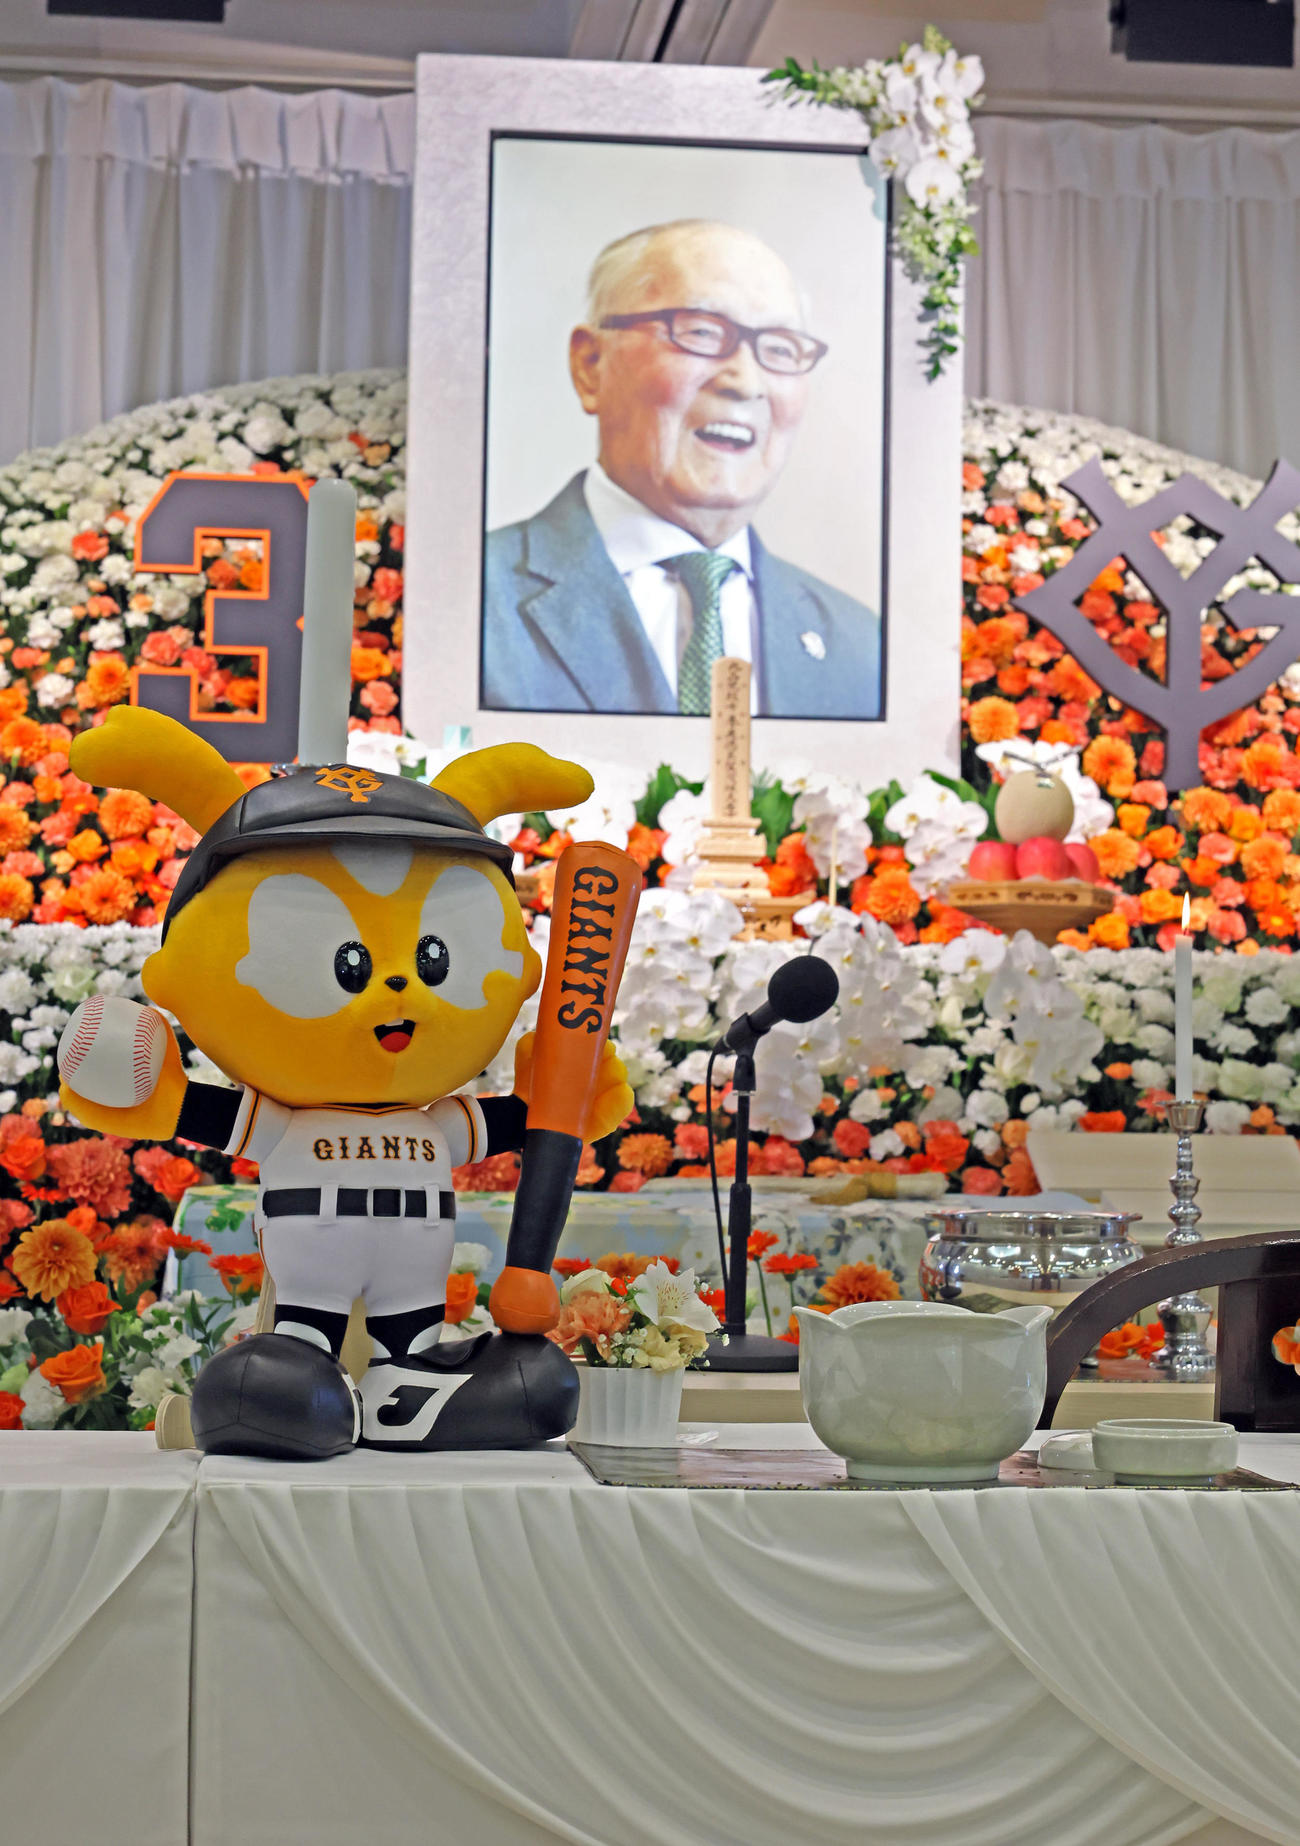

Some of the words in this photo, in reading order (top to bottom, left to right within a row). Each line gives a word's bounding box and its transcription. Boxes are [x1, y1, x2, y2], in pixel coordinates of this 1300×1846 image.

[129, 471, 310, 768] 3
[557, 866, 619, 1034] GIANTS
[312, 1135, 436, 1162] GIANTS
